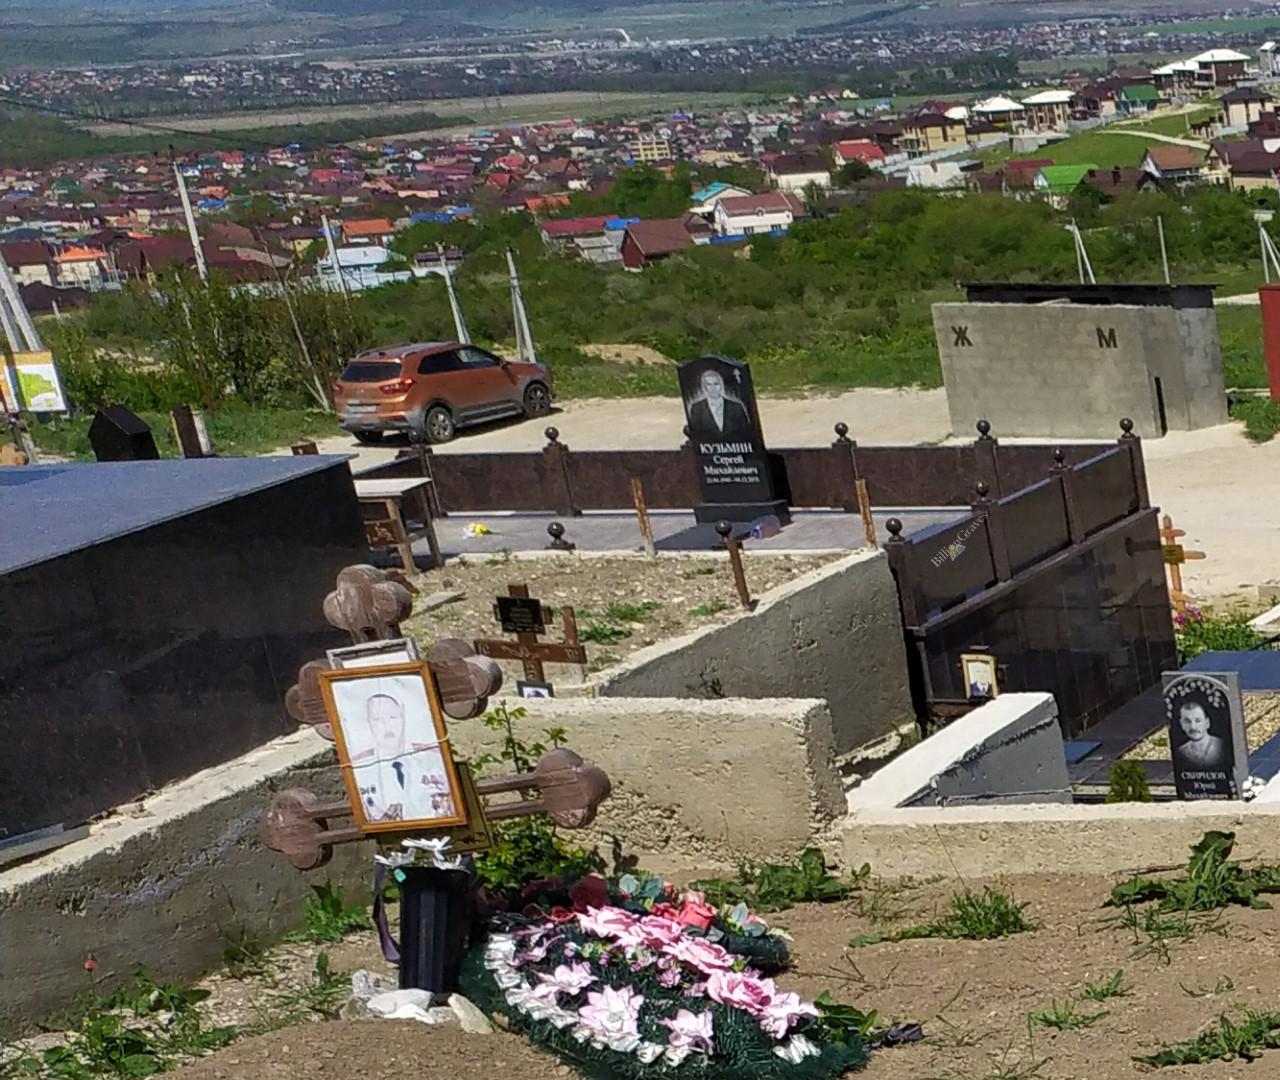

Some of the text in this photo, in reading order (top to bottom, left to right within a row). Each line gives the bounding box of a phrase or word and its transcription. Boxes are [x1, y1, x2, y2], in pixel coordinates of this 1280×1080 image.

[951, 326, 973, 347] Ж
[1096, 328, 1118, 348] М
[700, 442, 753, 454] КУЗЬМИН
[713, 455, 744, 466] Сергей
